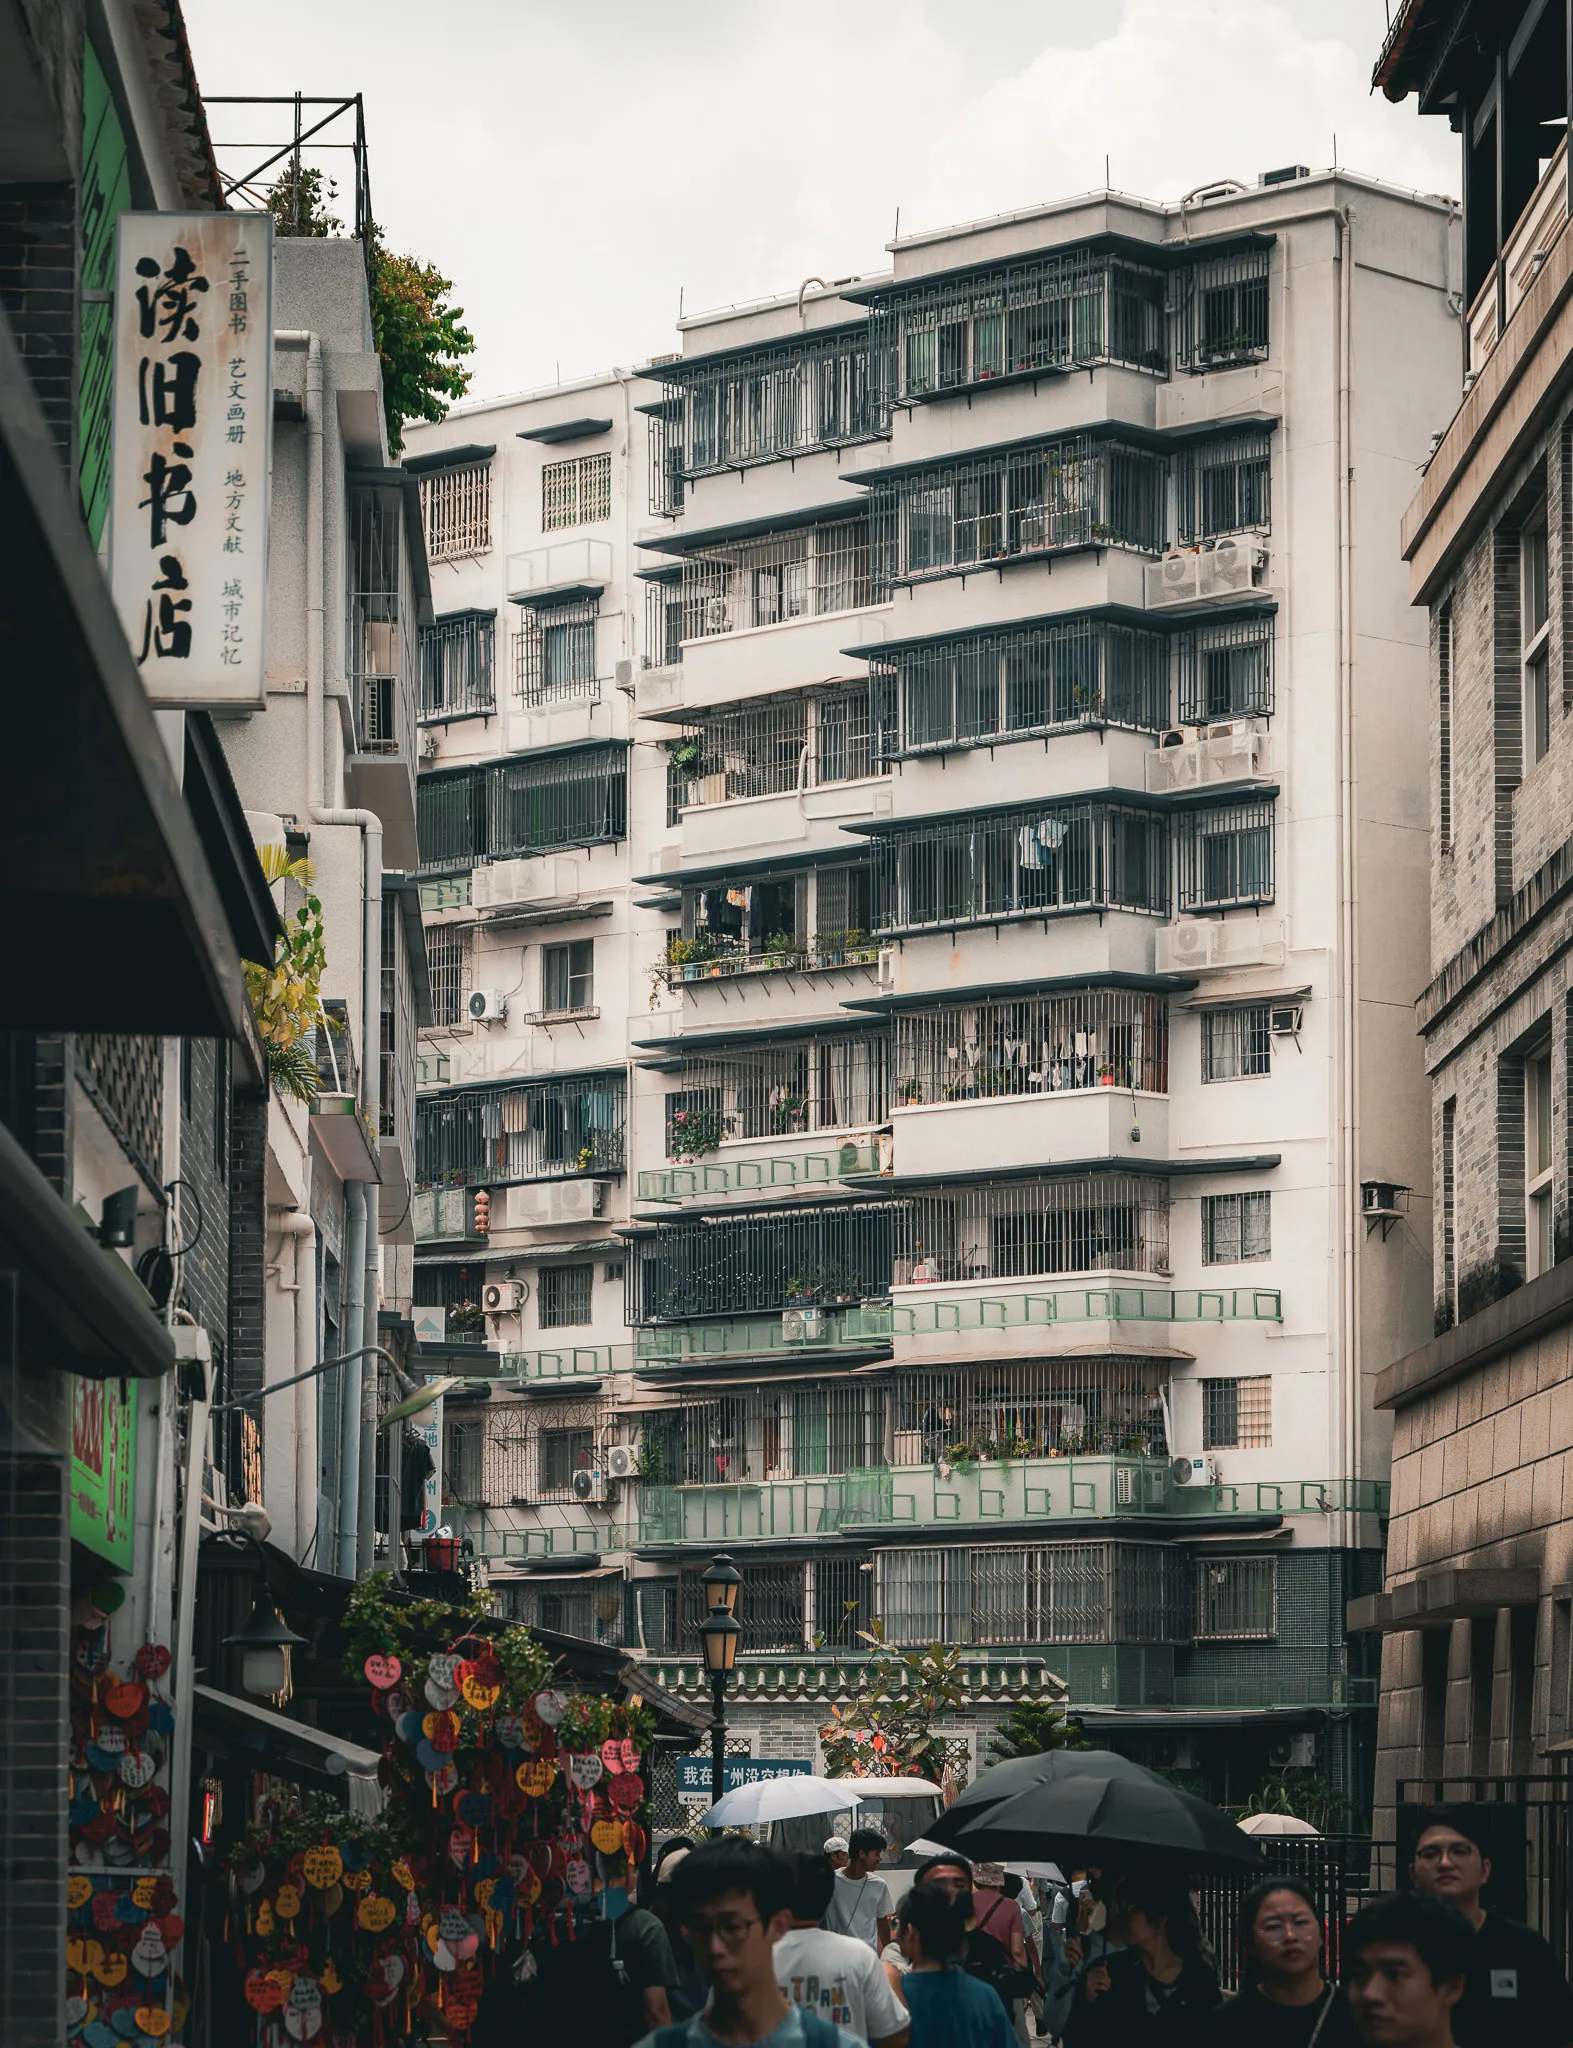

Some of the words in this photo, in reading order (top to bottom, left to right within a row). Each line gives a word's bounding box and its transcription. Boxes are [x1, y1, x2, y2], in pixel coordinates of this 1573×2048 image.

[229, 251, 248, 334] 二手图书
[226, 358, 246, 444] 艺文画册
[135, 247, 209, 666] 读旧书店
[223, 471, 245, 555] 地方文献
[221, 581, 243, 666] 城市记忆
